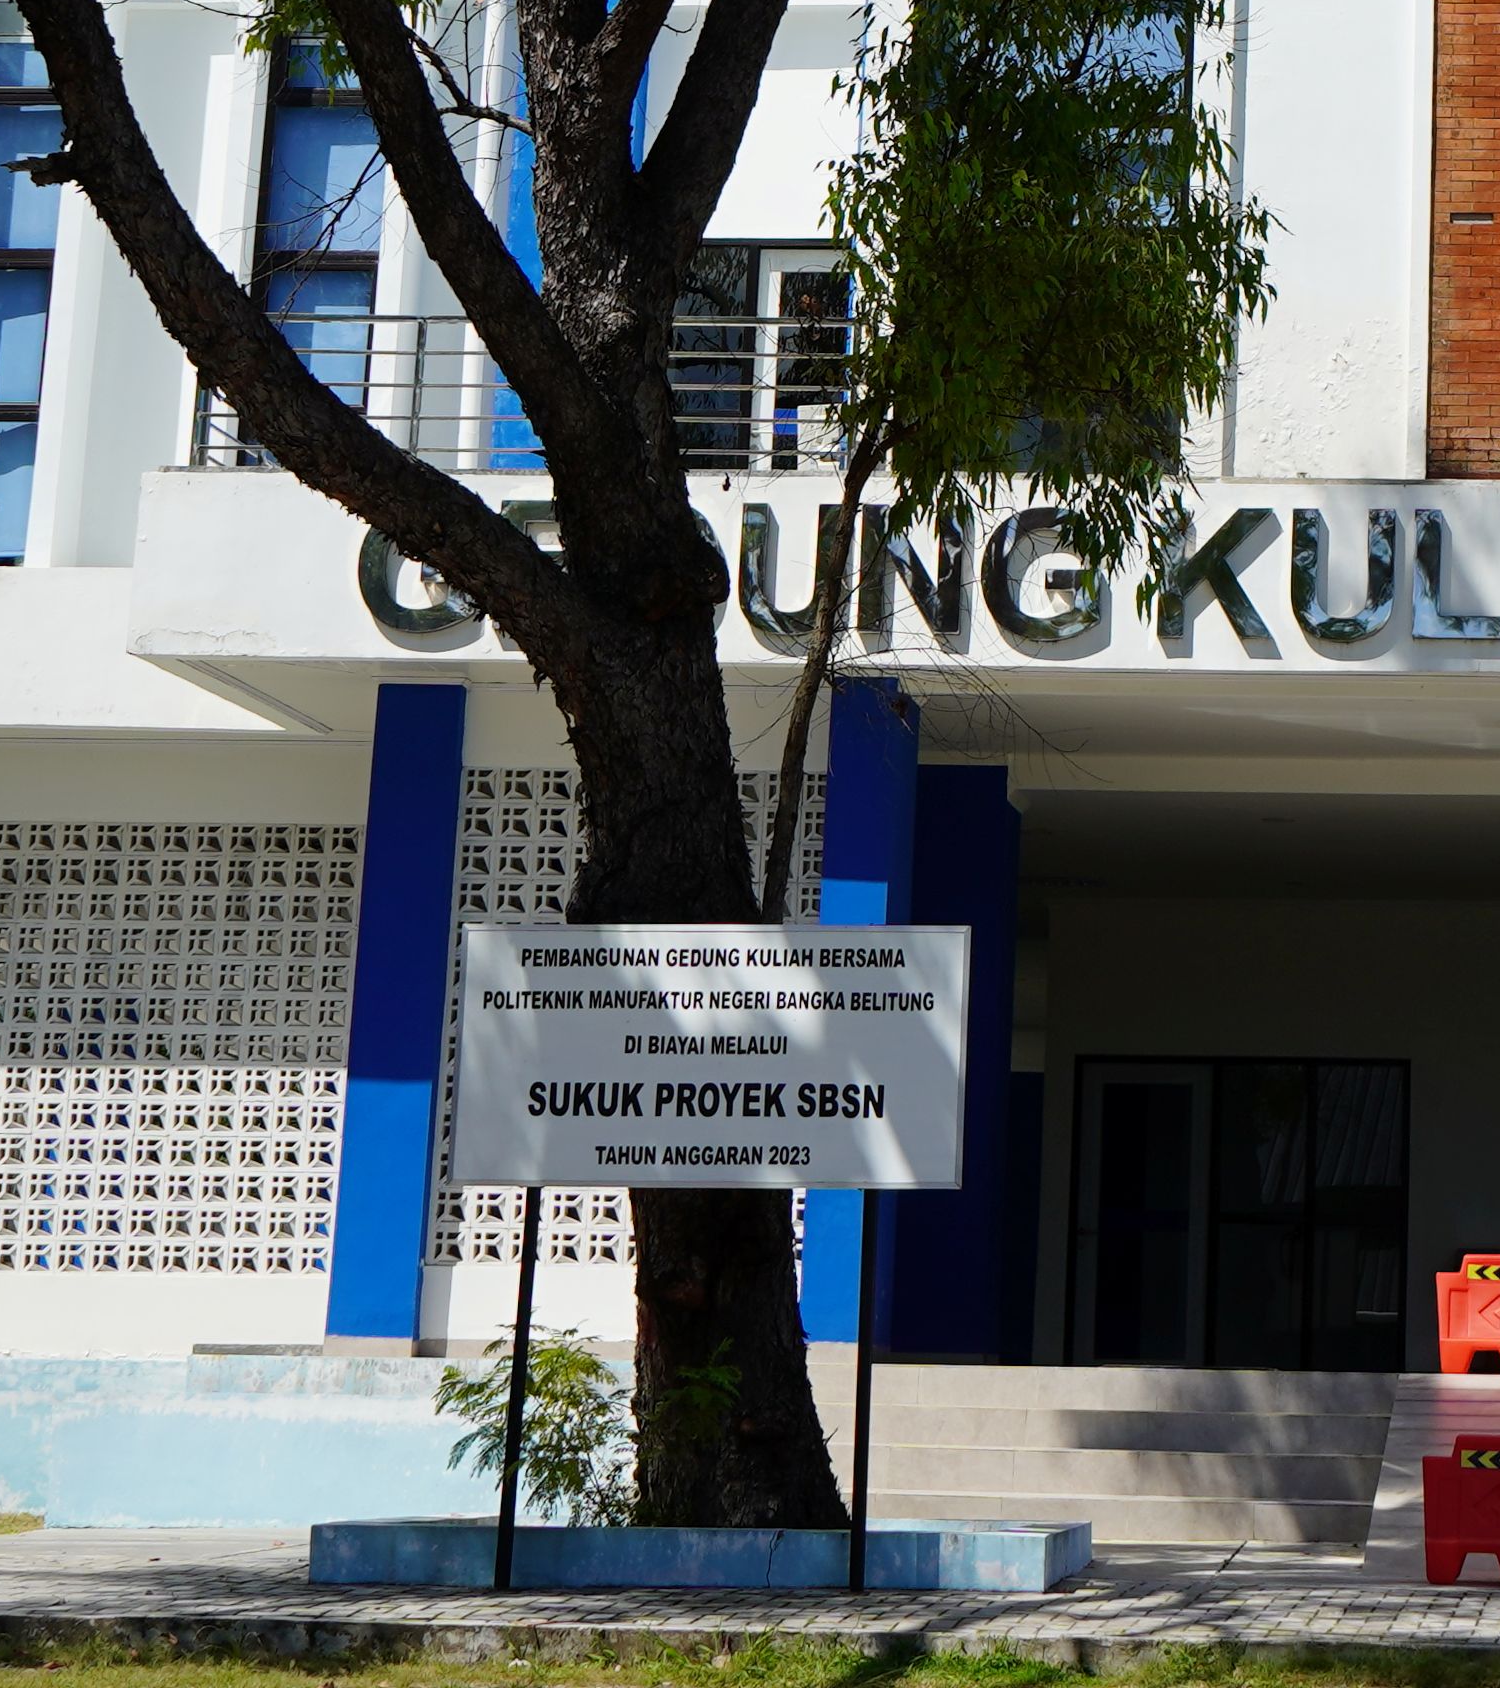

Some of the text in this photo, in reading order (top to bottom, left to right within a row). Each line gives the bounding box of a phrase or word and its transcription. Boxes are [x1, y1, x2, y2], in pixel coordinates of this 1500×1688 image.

[358, 499, 1103, 643] GUNG
[521, 947, 906, 968] PEMBANGUNAN GEDUNG KULIAH BERSAMA
[483, 989, 935, 1012] POLITEKNIK MANUFAKTUR NEGERI BANGKA BELITUNG
[624, 1034, 788, 1055] DI BIAYAI MELALUI
[527, 1081, 886, 1119] SUKUK PROYEK SBSN
[594, 1145, 812, 1166] TAHUN ANGGARAN 2023
